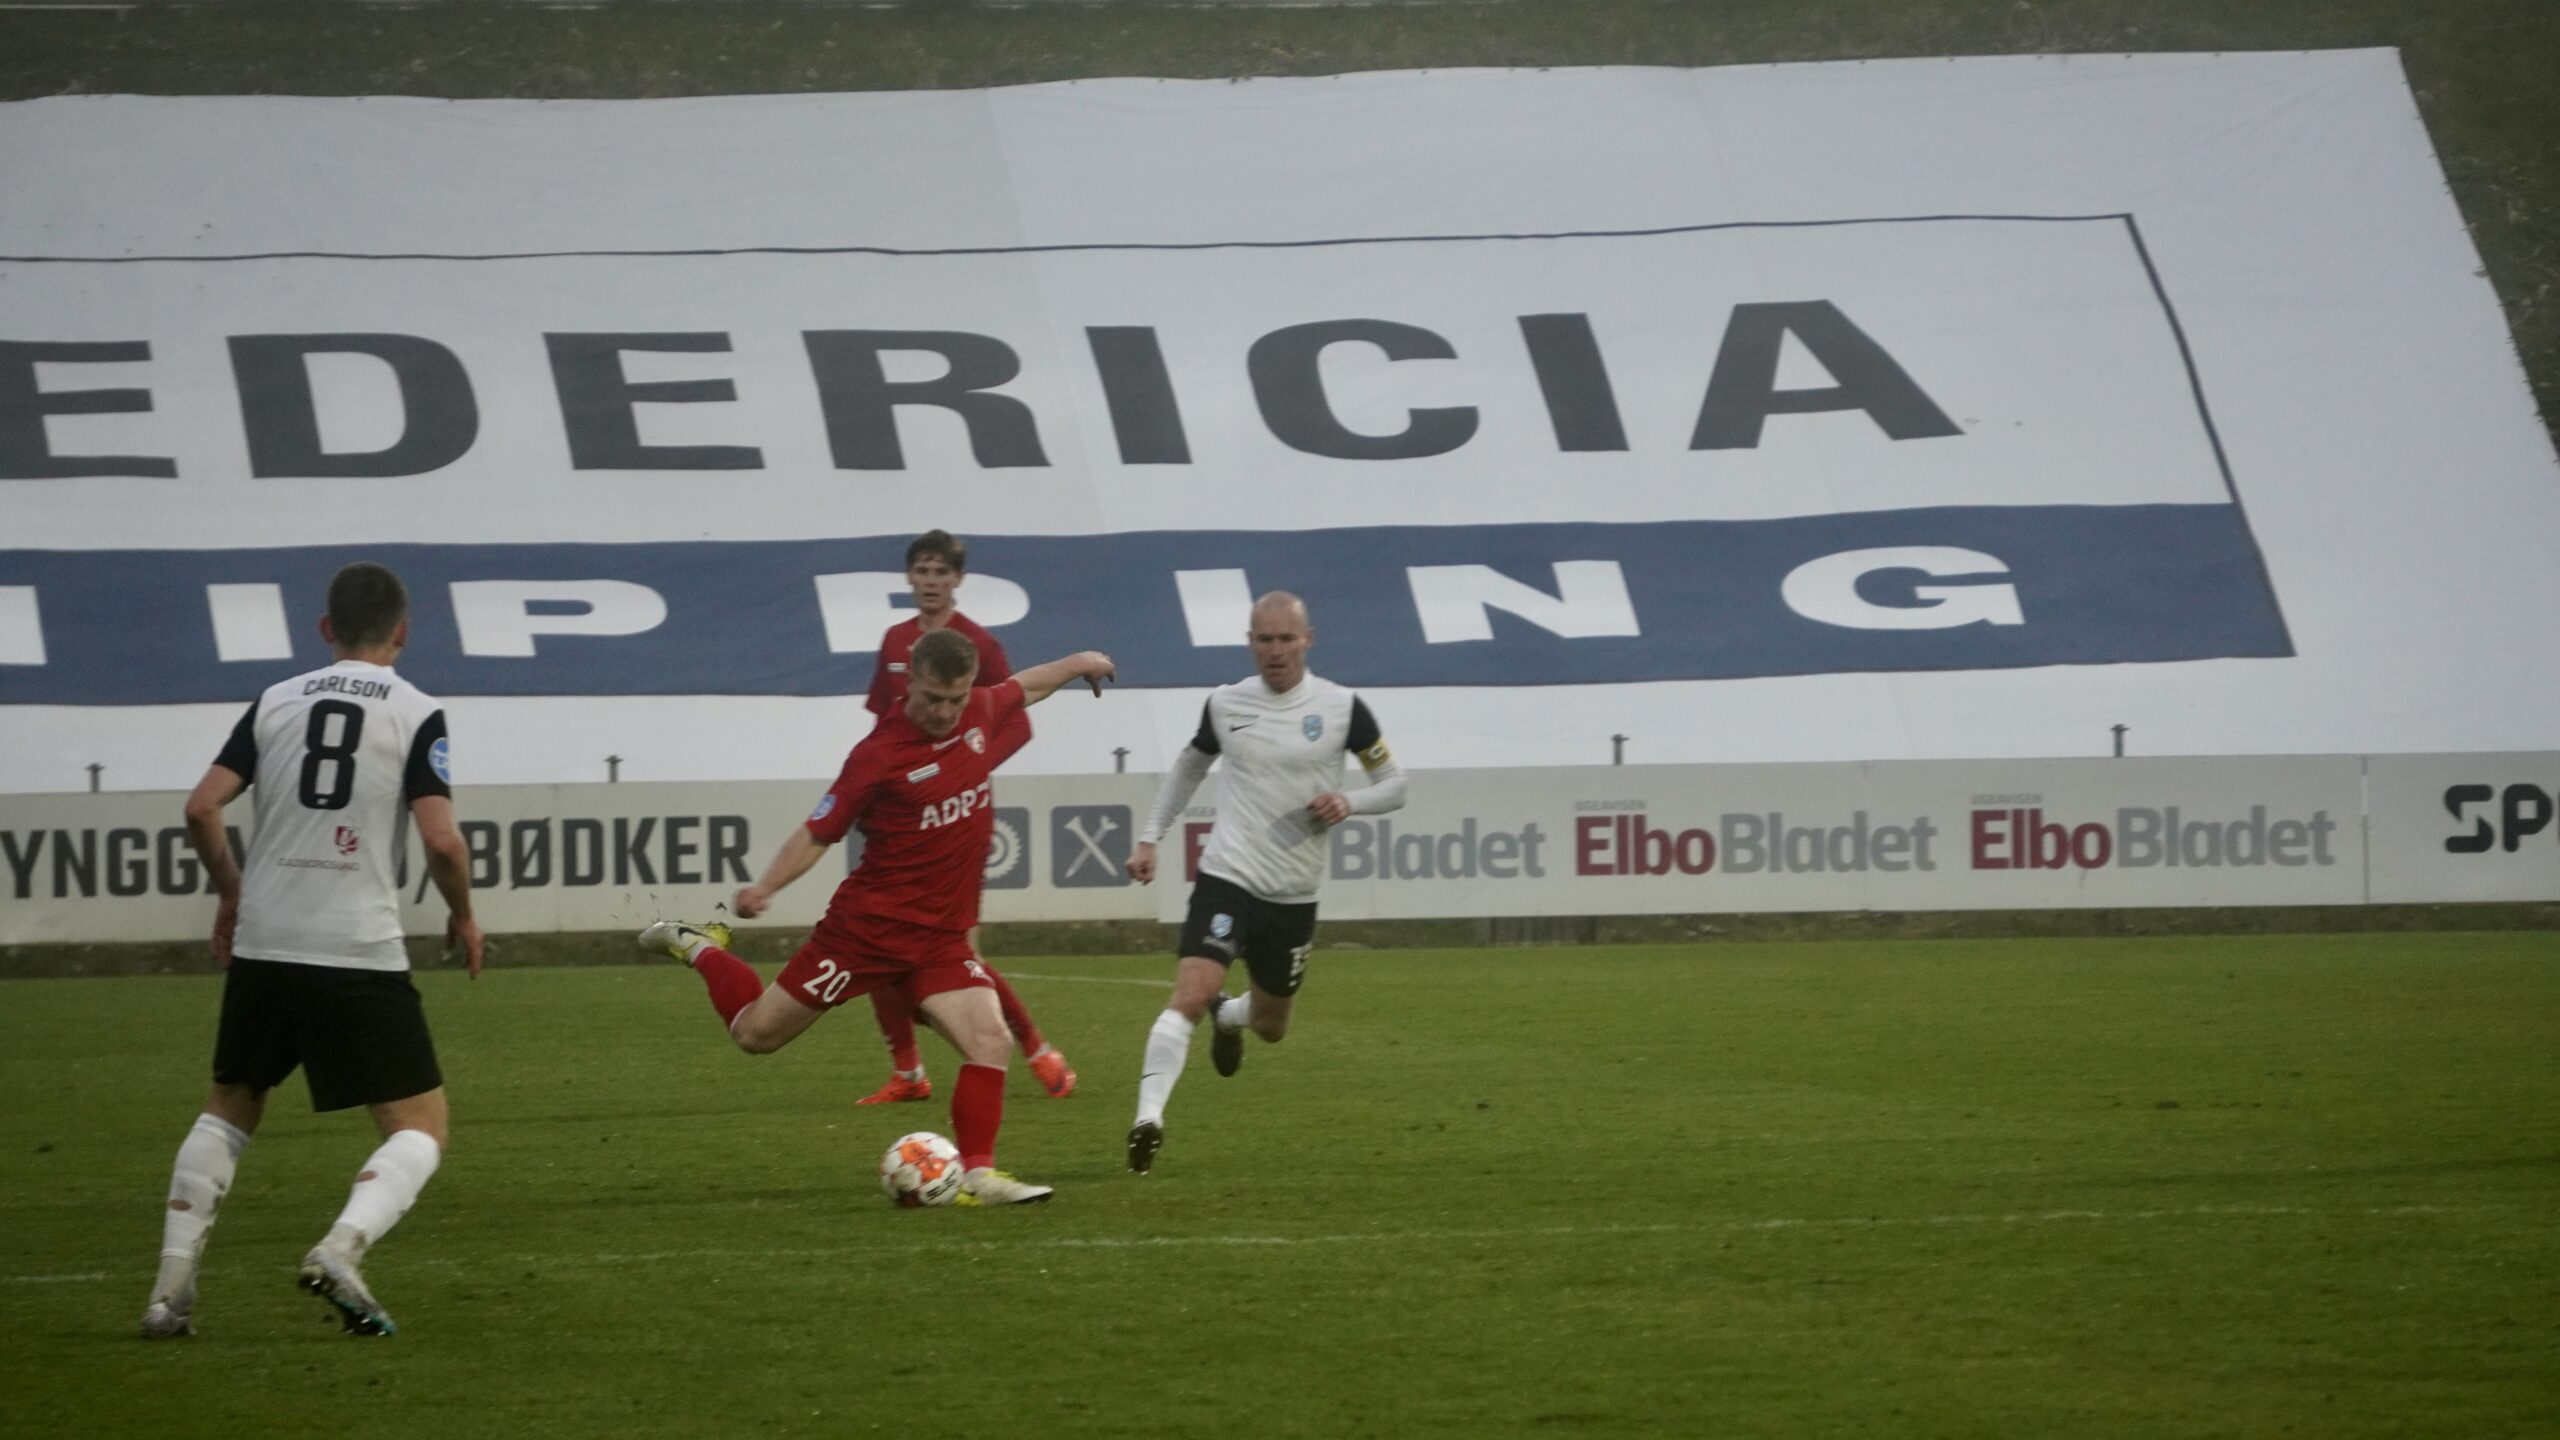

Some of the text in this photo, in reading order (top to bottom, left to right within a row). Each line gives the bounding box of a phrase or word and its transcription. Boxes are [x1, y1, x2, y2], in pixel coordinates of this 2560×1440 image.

[0, 299, 1965, 480] EDERICIA
[0, 546, 2024, 665] IPPING
[303, 675, 392, 700] CARLSON
[298, 698, 366, 811] 8
[1575, 810, 1937, 876] ElboBladet
[1970, 805, 2336, 870] ElboBladet
[2443, 783, 2560, 854] SP
[803, 958, 852, 1004] 20
